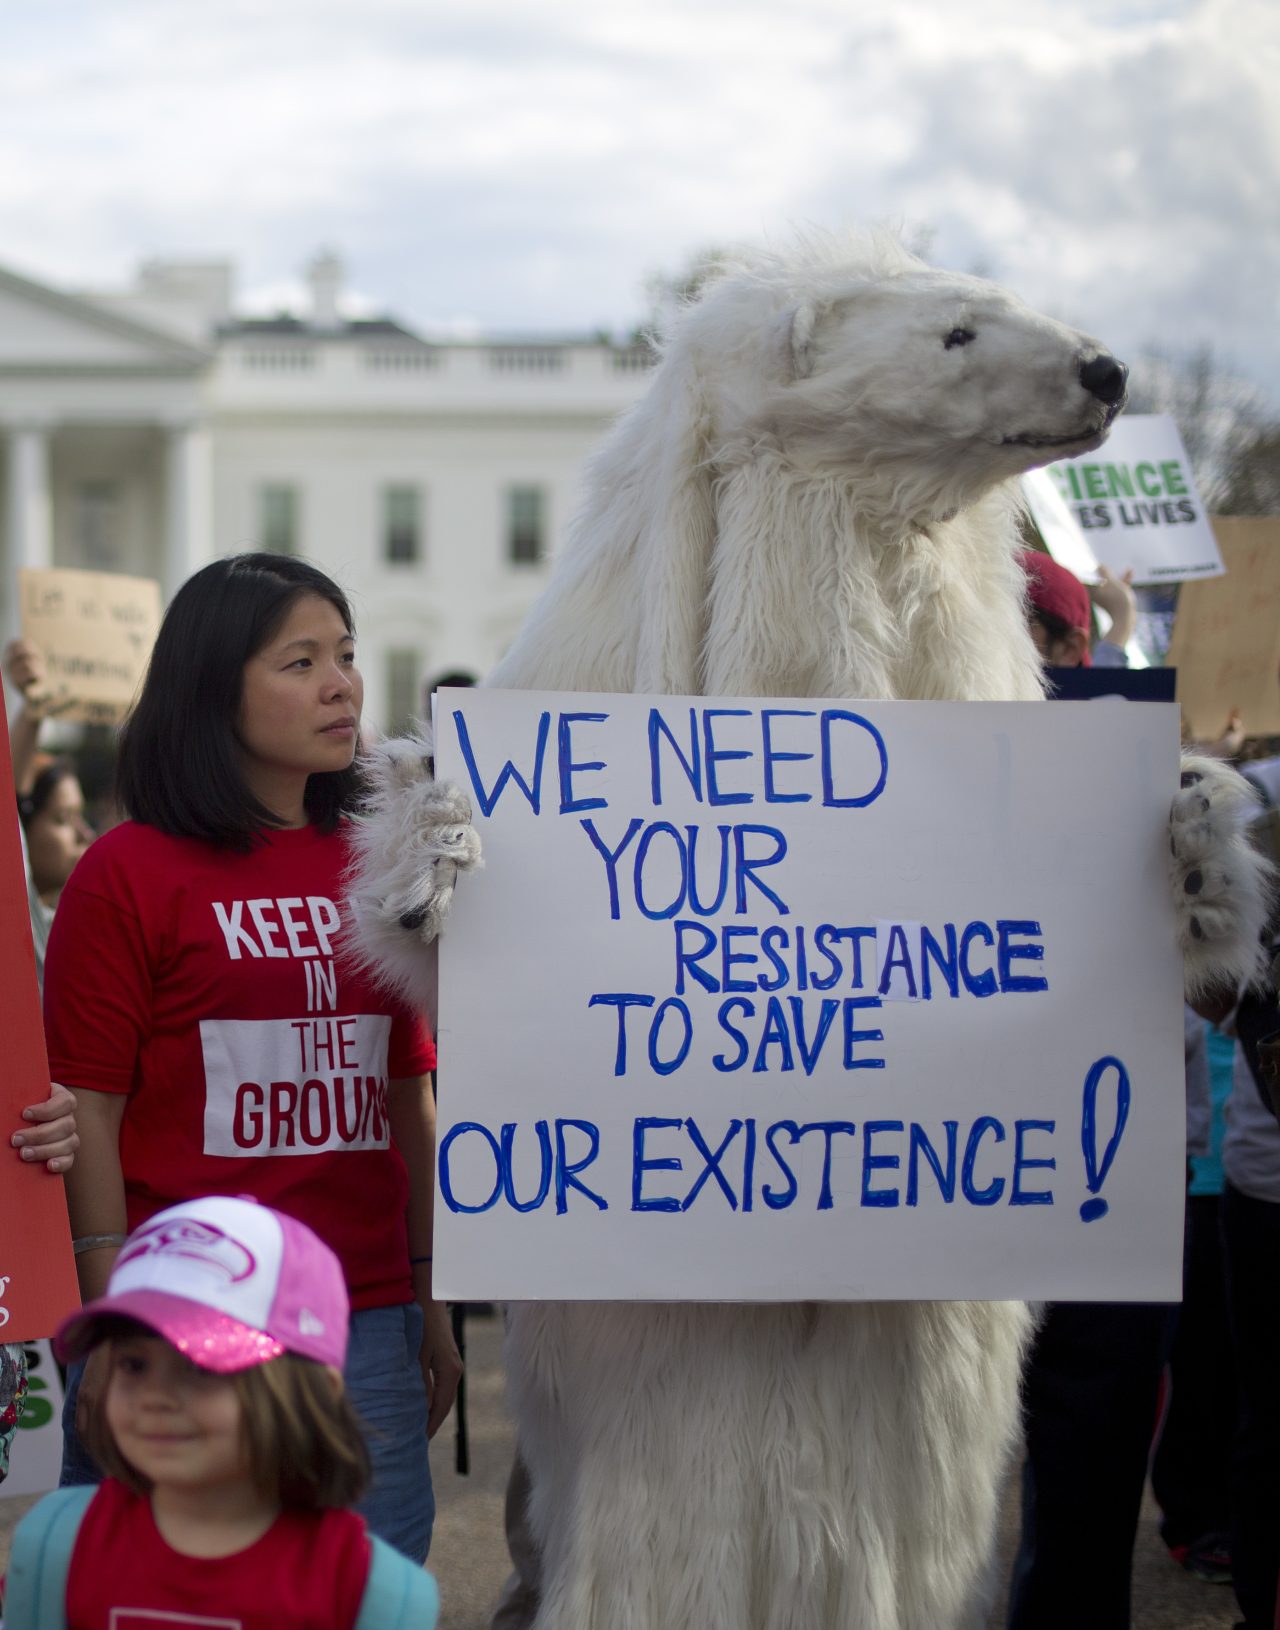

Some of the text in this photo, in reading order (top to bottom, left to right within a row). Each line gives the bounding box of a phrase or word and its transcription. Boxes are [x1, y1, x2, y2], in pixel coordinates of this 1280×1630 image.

[1048, 460, 1189, 501] IENCE
[1119, 499, 1198, 527] LIVES
[453, 707, 888, 818] WE NEED
[580, 817, 790, 920] YOUR
[211, 895, 342, 960] KEEP
[675, 919, 1049, 1000] RESISTANCE
[304, 959, 337, 1012] IN
[291, 1018, 359, 1073] THE
[588, 992, 886, 1077] TO SAVE
[233, 1075, 388, 1149] GROUN
[438, 1118, 609, 1216] OUR
